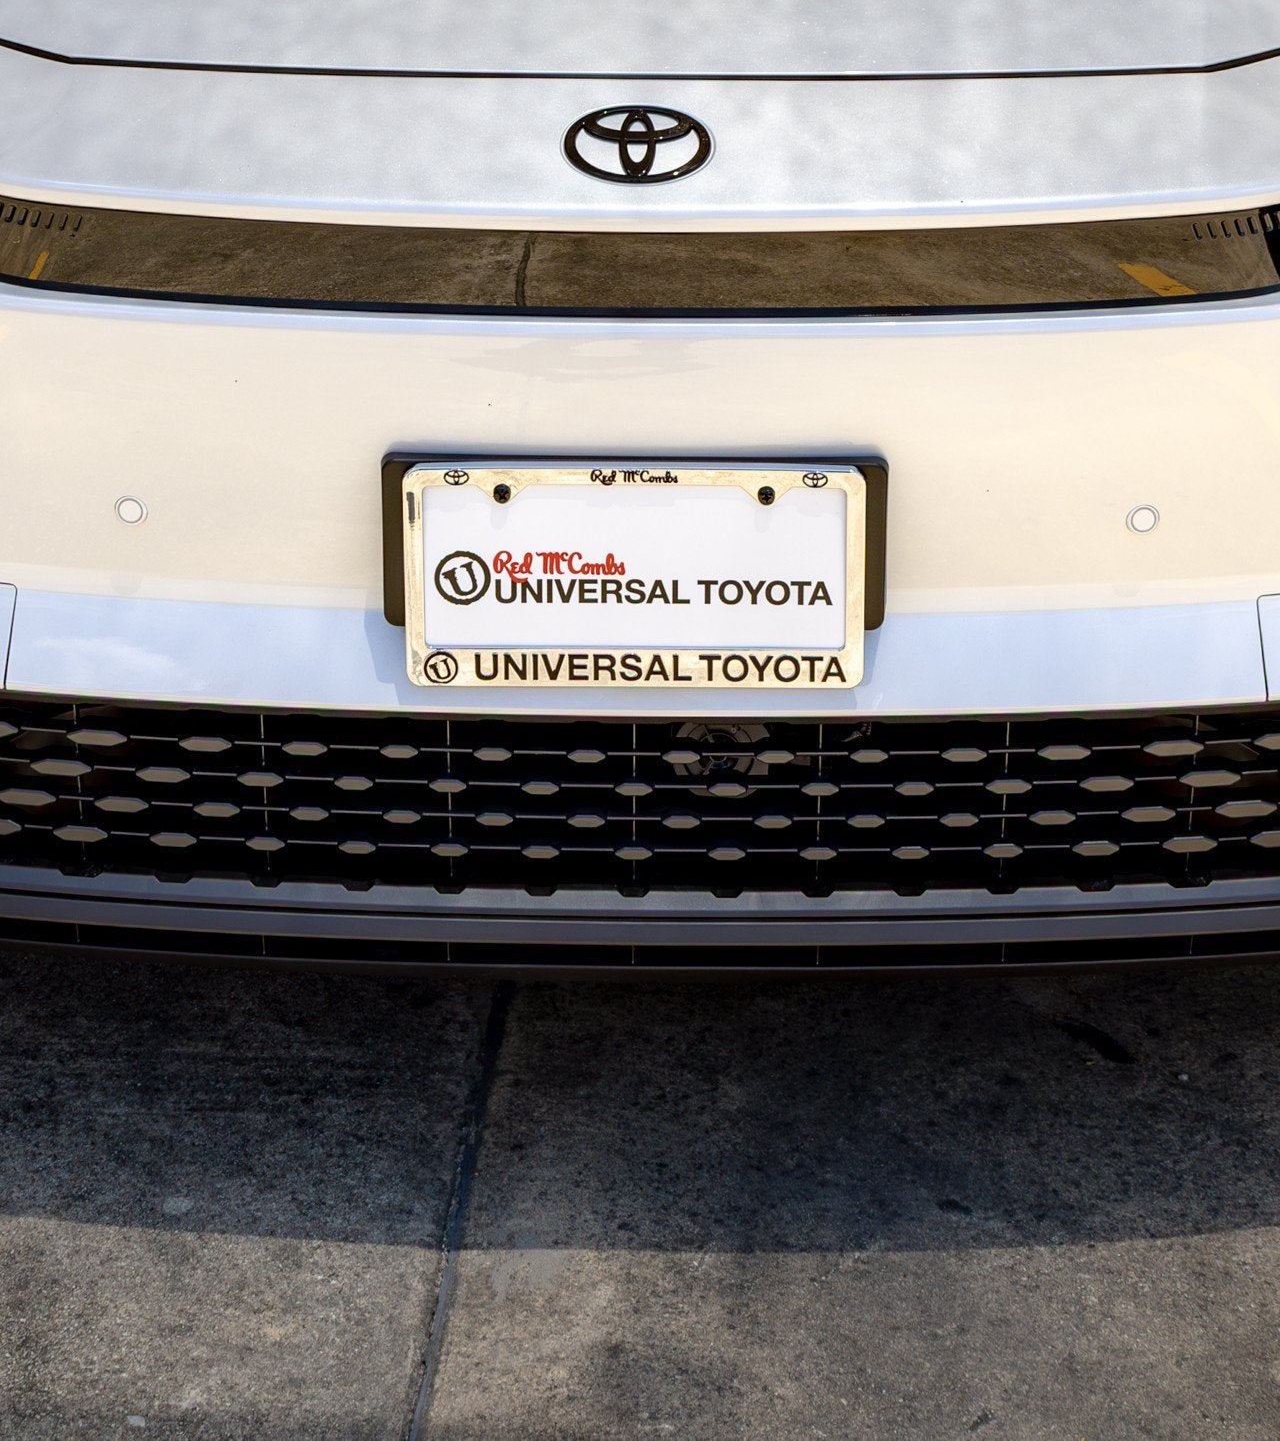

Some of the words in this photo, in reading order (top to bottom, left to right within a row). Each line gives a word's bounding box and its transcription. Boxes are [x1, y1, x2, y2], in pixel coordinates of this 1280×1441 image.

[590, 468, 617, 486] Red
[618, 469, 679, 484] McCombs
[492, 550, 534, 584] Red
[535, 551, 626, 576] McCombs
[494, 578, 691, 605] UNIVERSAL
[697, 579, 834, 606] TOYOTA
[474, 652, 693, 681] UNIVERSAL
[698, 653, 847, 683] TOYOTA
